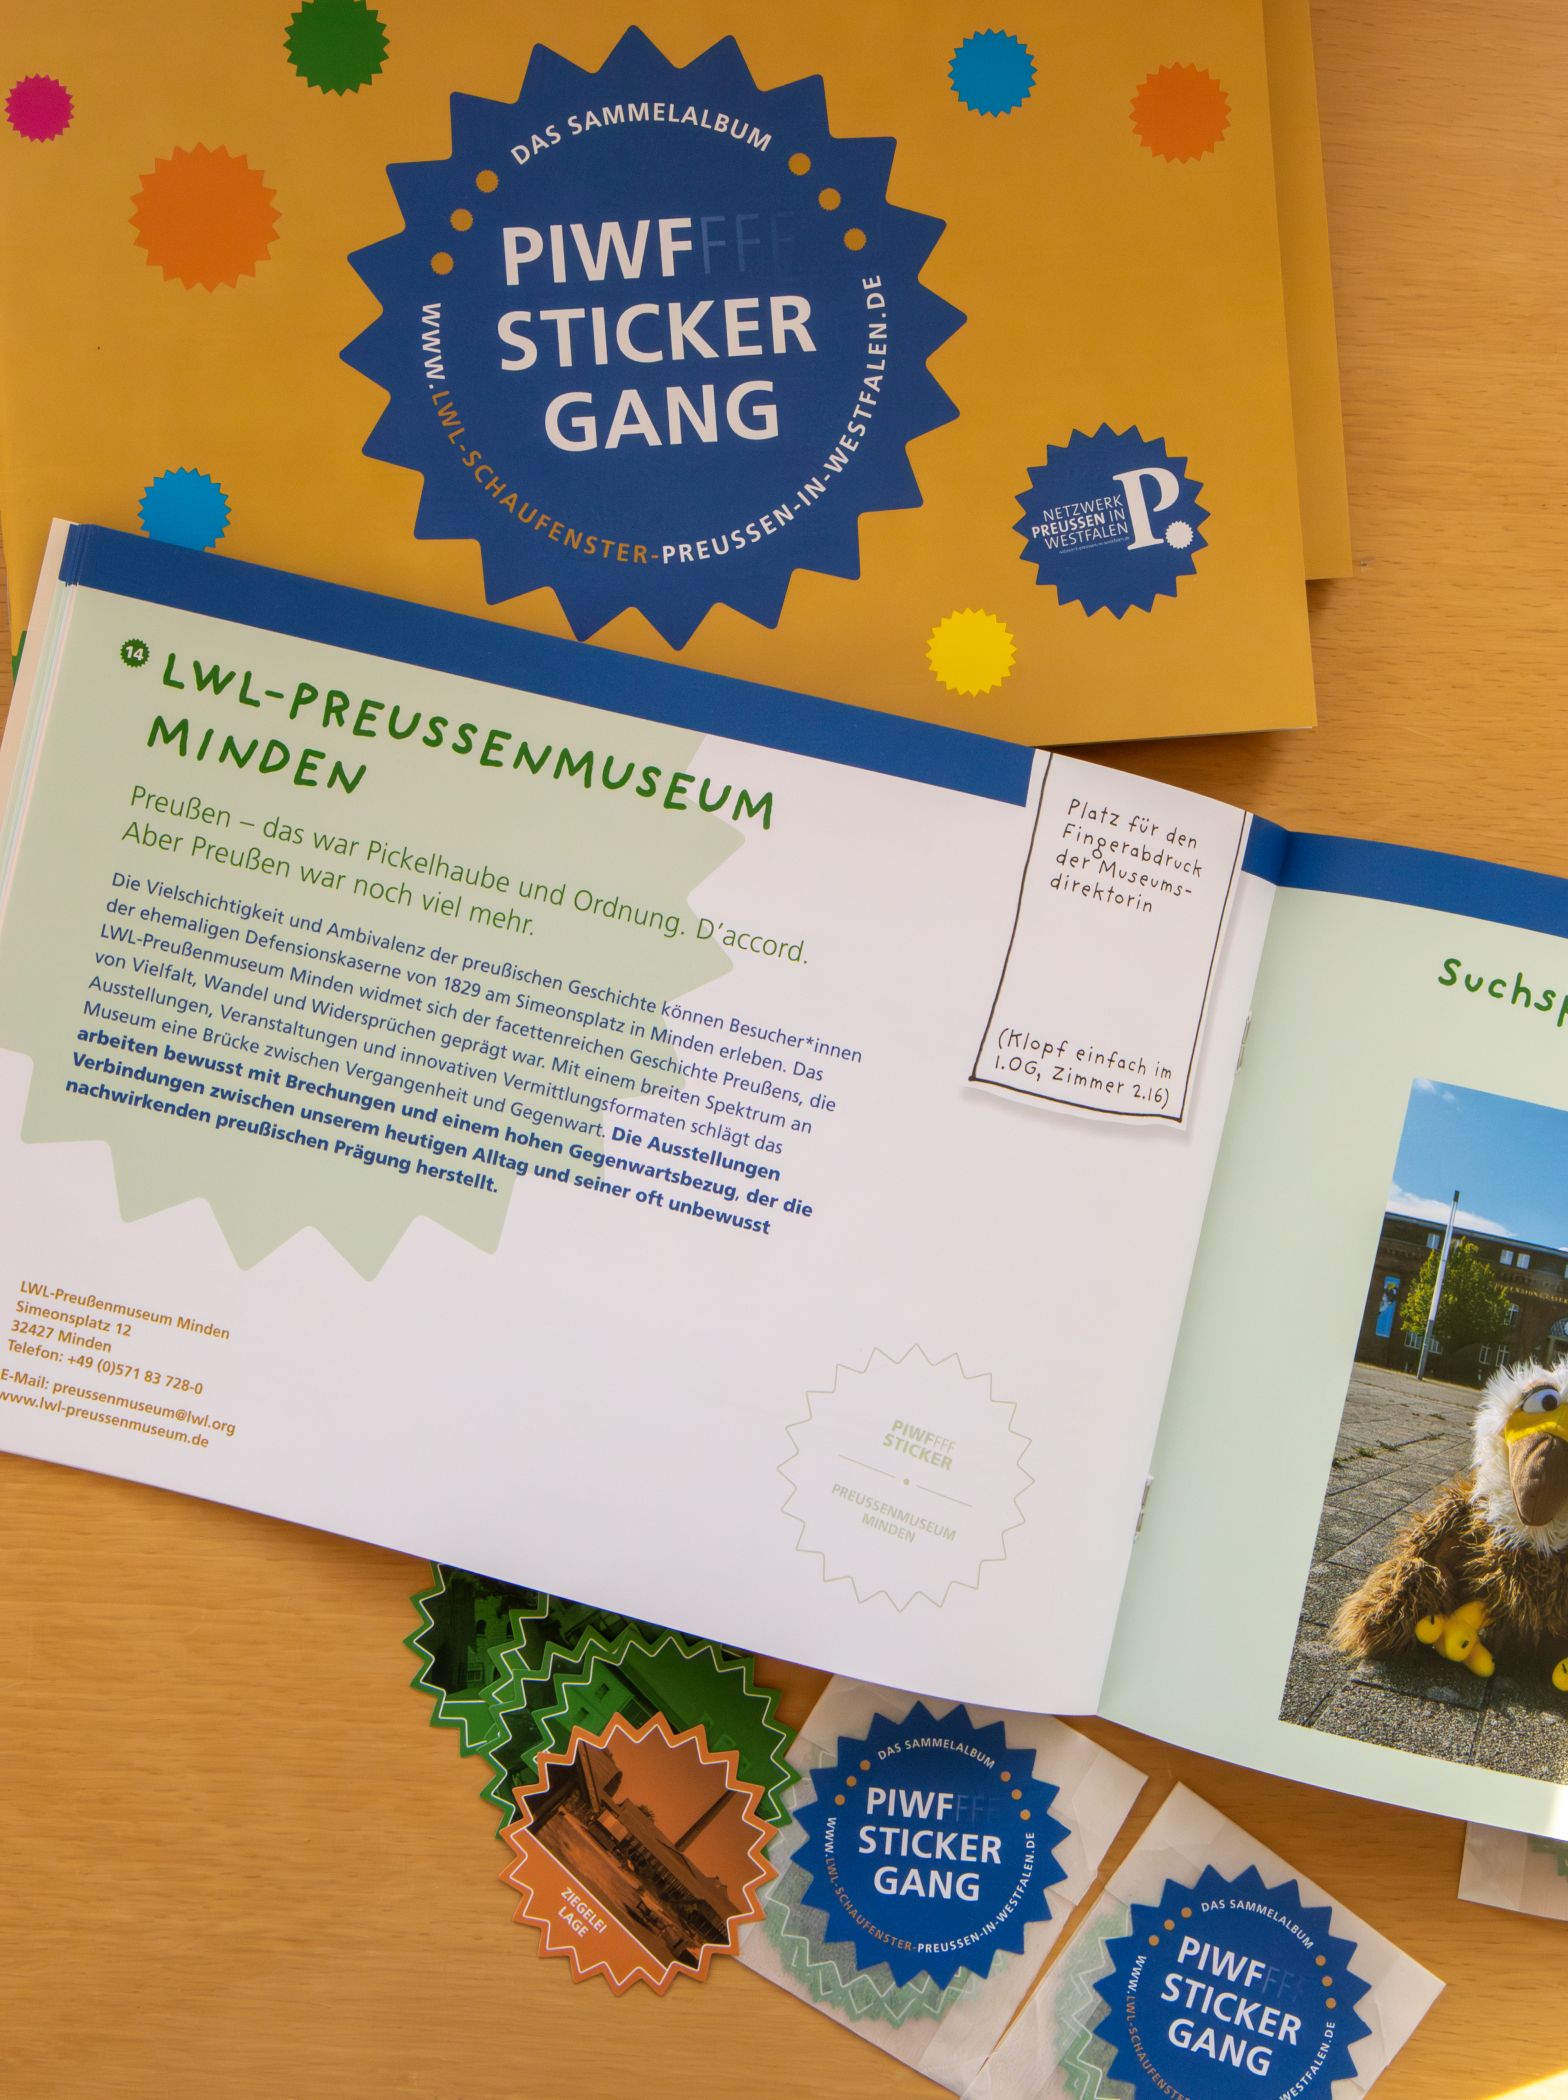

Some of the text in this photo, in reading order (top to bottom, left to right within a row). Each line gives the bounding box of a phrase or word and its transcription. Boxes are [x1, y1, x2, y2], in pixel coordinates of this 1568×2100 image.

[510, 102, 772, 165] DAS SAMMELALBUM
[497, 295, 817, 372] STICKER
[544, 380, 779, 452] GANG
[1032, 508, 1126, 539] PREUSSEN IN
[1043, 494, 1124, 523] NETZWERK
[1044, 522, 1129, 550] WESTFALEN
[126, 645, 144, 661] 14
[146, 715, 367, 794] MINDEN
[162, 652, 773, 830] LWL-PREUSSENMUSEUM
[1062, 823, 1202, 879] Fingerabdruck
[1067, 798, 1198, 850] Platz für den
[120, 821, 533, 936] Aber Preußen war noch viel mehr.
[130, 784, 231, 828] Preußen
[262, 816, 305, 845] das
[313, 831, 360, 857] war
[366, 839, 510, 893] Pickelhaube
[518, 880, 566, 906] und
[573, 889, 685, 938] Ordnung.
[1056, 848, 1193, 898] der Museums-
[1050, 873, 1153, 913] direktorin
[111, 871, 141, 892] Die
[146, 879, 285, 925] Vielschichtigkeit
[289, 915, 323, 934] und
[325, 922, 426, 958] Ambivalenz
[429, 946, 459, 965] der
[461, 956, 563, 991] preußischen
[567, 979, 657, 1013] Geschichte
[660, 1000, 724, 1030] können
[100, 923, 836, 1112] LWL-Preußenmuseum Minden widmet sich der facettenreichen Geschichte Preußens, die
[106, 897, 824, 1082] der ehemaligen Defensionskaserne von 1829 am Simeonsplatz in Minden erleben. Das
[87, 975, 783, 1155] Ausstellungen, Veranstaltungen und innovativen Vermittlungsformaten schlägt das
[95, 951, 812, 1134] von Vielfalt, Wandel und Widersprüchen geprägt war. Mit einem breiten Spektrum an
[998, 1027, 1172, 1080] (Klopf einfach im
[83, 999, 781, 1182] Museum eine Brücke zwischen Vergangenheit und Gegenwart. Die Ausstellungen
[1052, 1065, 1125, 1096] Zimmer
[1132, 1083, 1171, 1110] 2.16)
[65, 1080, 498, 1193] nachwirkenden preußischen Prägung herstellt.
[73, 1051, 771, 1235] Verbindungen zwischen unserem heutigen Alltag und seiner oft unbewusst
[76, 1029, 813, 1217] arbeiten bewusst mit Brechungen und einem hohen Gegenwartsbezug, der die
[10, 1319, 112, 1353] 32427 Minden
[15, 1299, 132, 1337] Simeonsplatz 12
[20, 1280, 230, 1340] LWL-Preußenmuseum Minden
[7, 1338, 203, 1395] Telefon: +49 (0)571 83 728-0
[0, 1367, 236, 1437] E-Mail: preussenmuseum@lwl.org
[882, 1433, 953, 1471] STICKER
[831, 1483, 957, 1542] PREUSSENMUSEUM
[861, 1513, 916, 1543] MINDEN
[877, 1737, 995, 1769] DAS SAMMELALBUM
[858, 1826, 1002, 1864] STICKER
[560, 1887, 607, 1935] ZIEGELEI
[874, 1866, 981, 1901] GANG
[558, 1906, 589, 1938] LAGE
[1201, 1899, 1314, 1950] DAS SAMMELALBUM
[1161, 1973, 1302, 2046] STICKER
[1168, 2018, 1273, 2076] GANG
